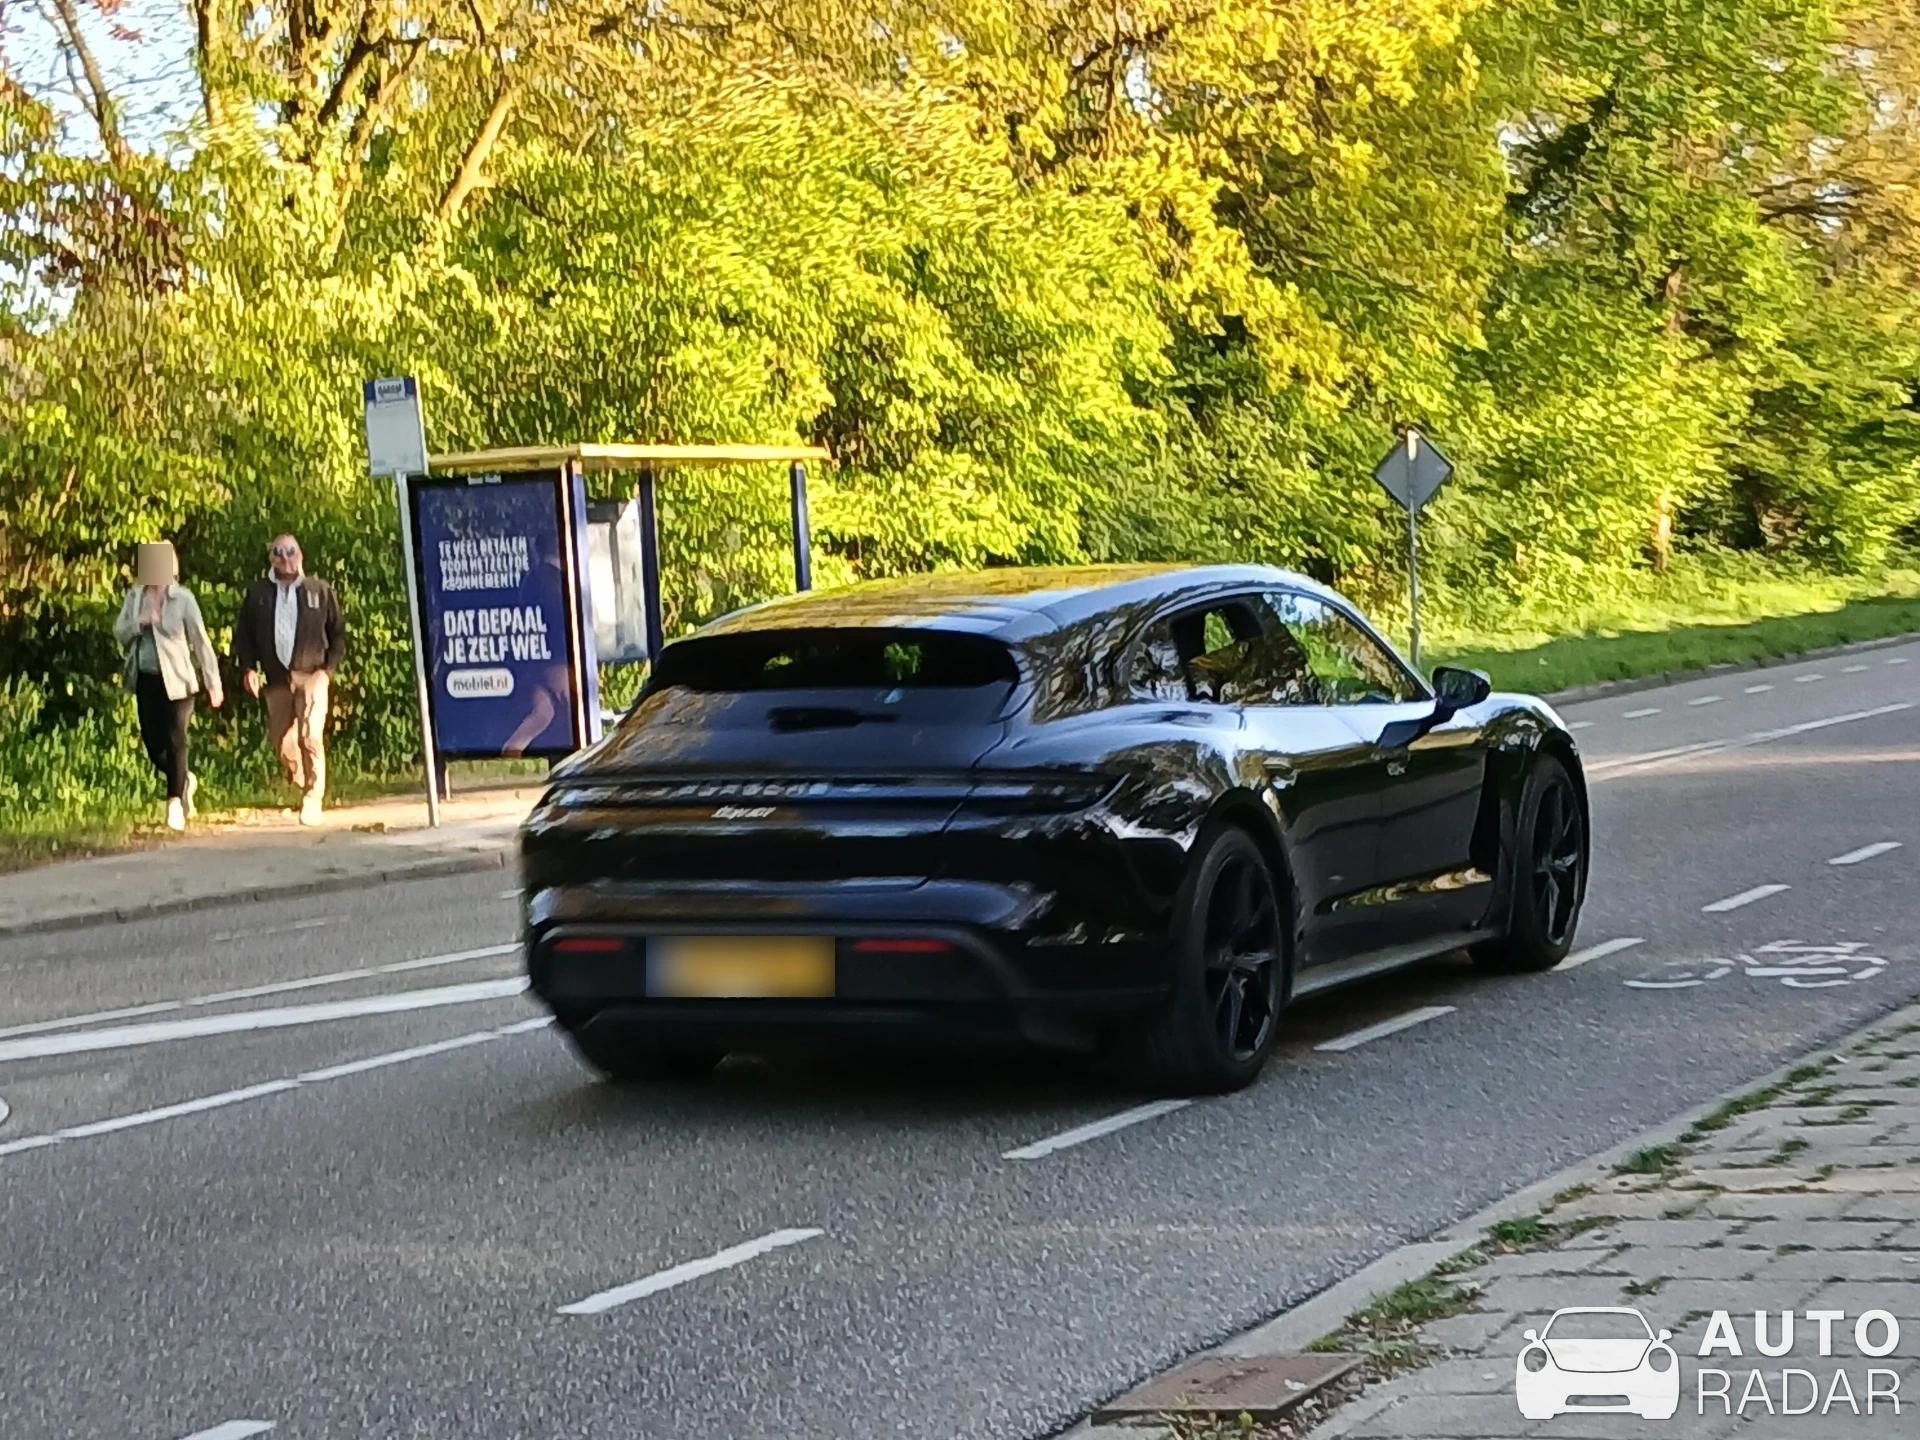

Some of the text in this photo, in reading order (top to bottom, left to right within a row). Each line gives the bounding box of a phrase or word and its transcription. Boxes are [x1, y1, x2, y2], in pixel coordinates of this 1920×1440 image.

[444, 605, 547, 637] DAT BEPAAL
[444, 633, 551, 664] JE ZELF WEL
